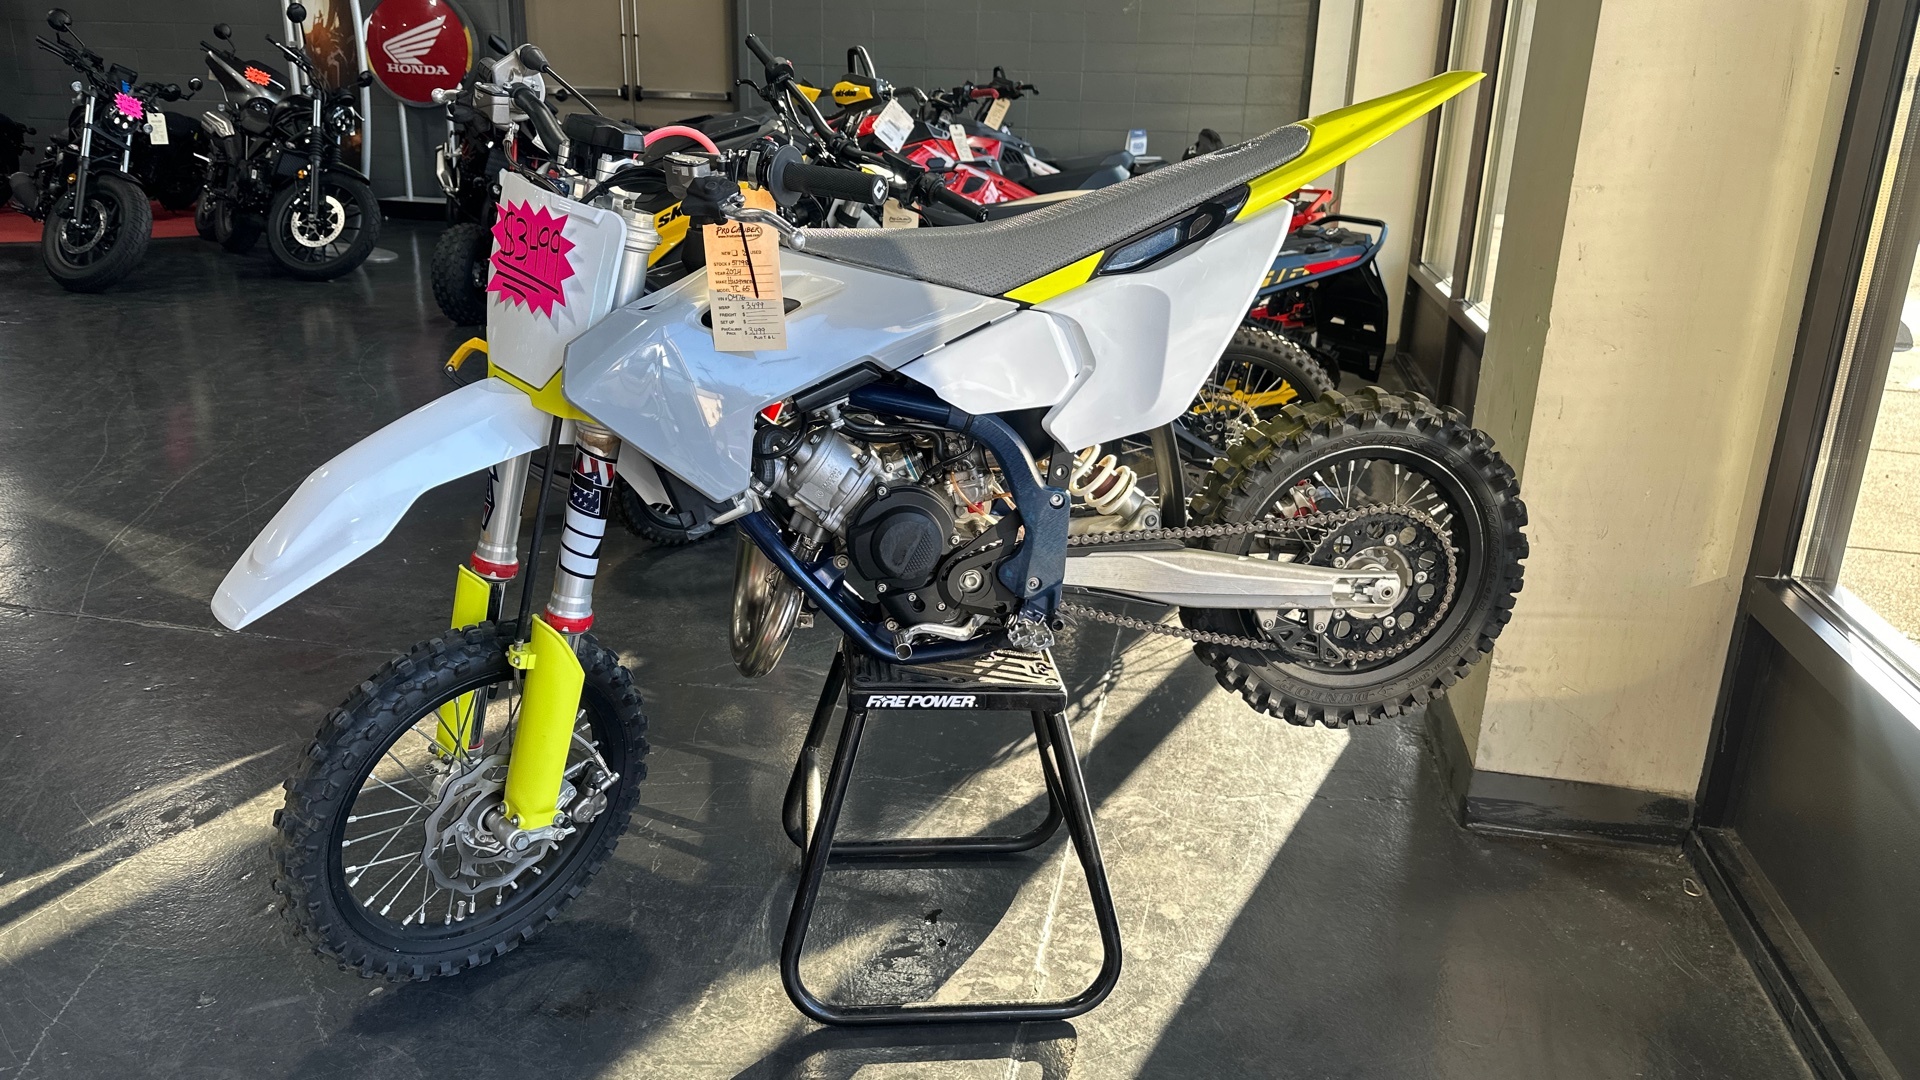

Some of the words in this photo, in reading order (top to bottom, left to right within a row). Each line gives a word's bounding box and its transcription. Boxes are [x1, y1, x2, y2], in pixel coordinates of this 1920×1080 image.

[386, 62, 450, 76] HONDA
[716, 226, 729, 236] PRO
[730, 225, 761, 234] CAIBER
[1406, 671, 1430, 688] SERVICE
[1280, 681, 1370, 704] DUNLOP
